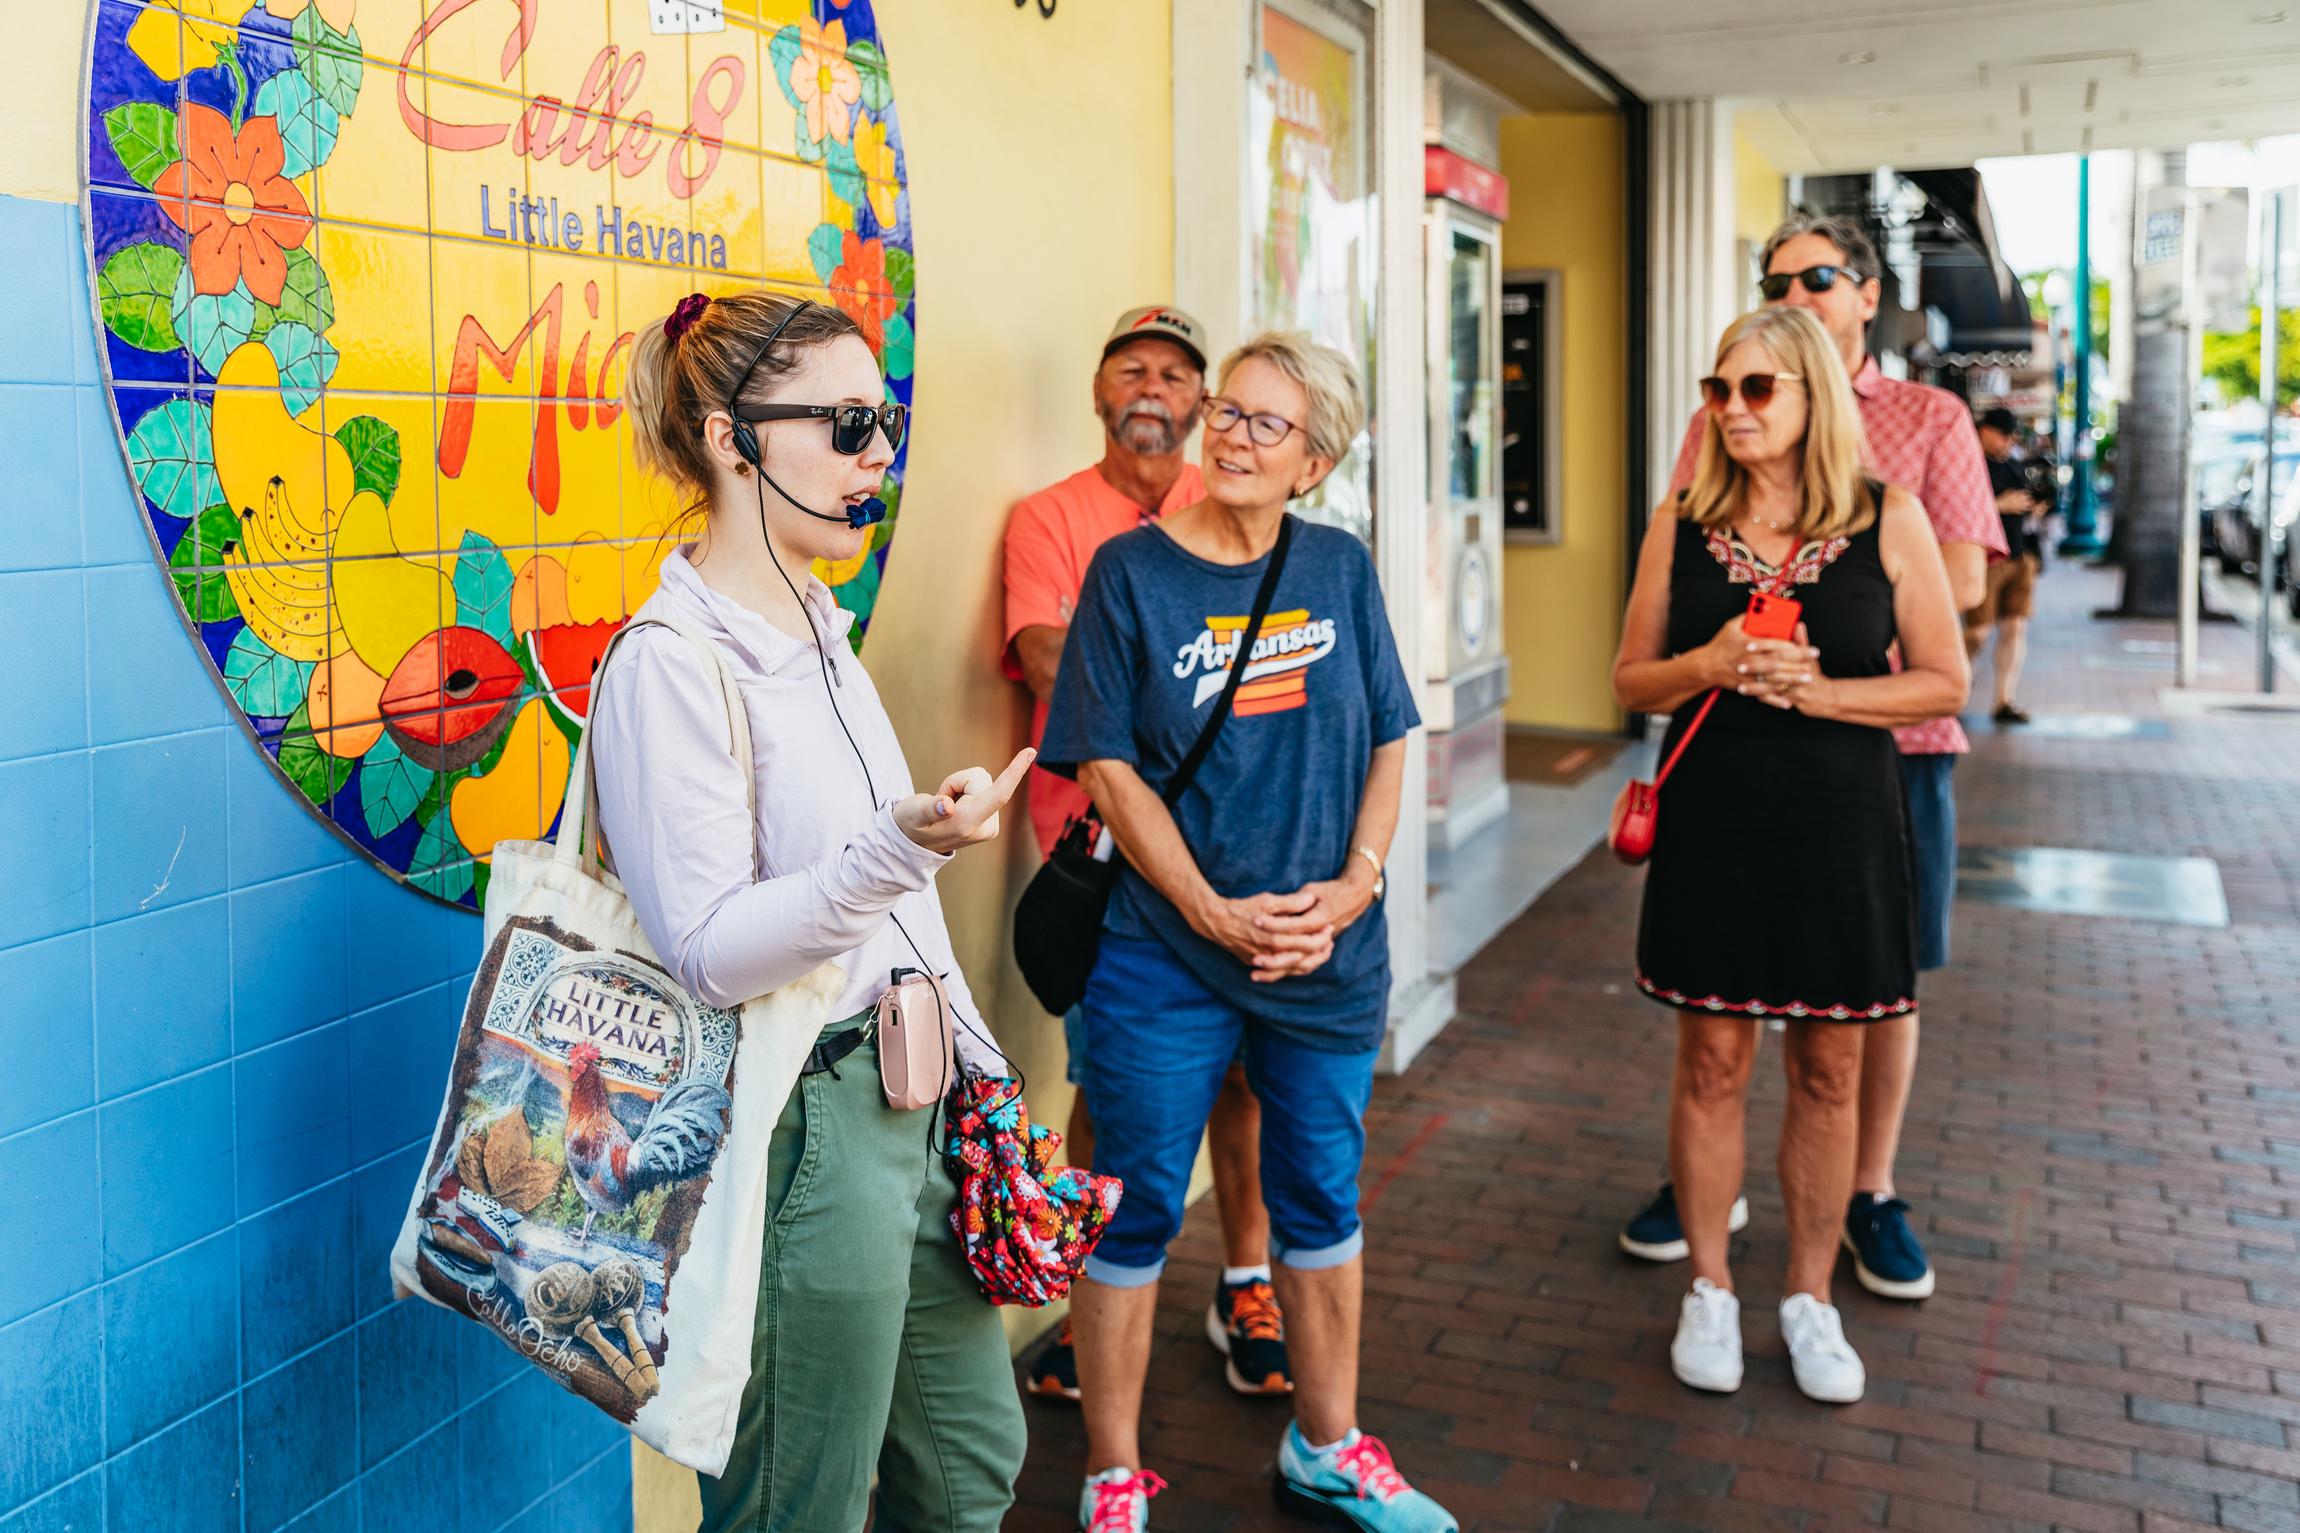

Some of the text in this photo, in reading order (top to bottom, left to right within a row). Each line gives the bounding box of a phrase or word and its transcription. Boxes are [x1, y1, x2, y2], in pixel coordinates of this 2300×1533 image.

[398, 0, 745, 200] Calle 8
[480, 184, 728, 270] Little Havana
[546, 998, 668, 1057] HAVANA
[567, 981, 667, 1030] LITTLE
[466, 1283, 587, 1372] Calle Ocho
